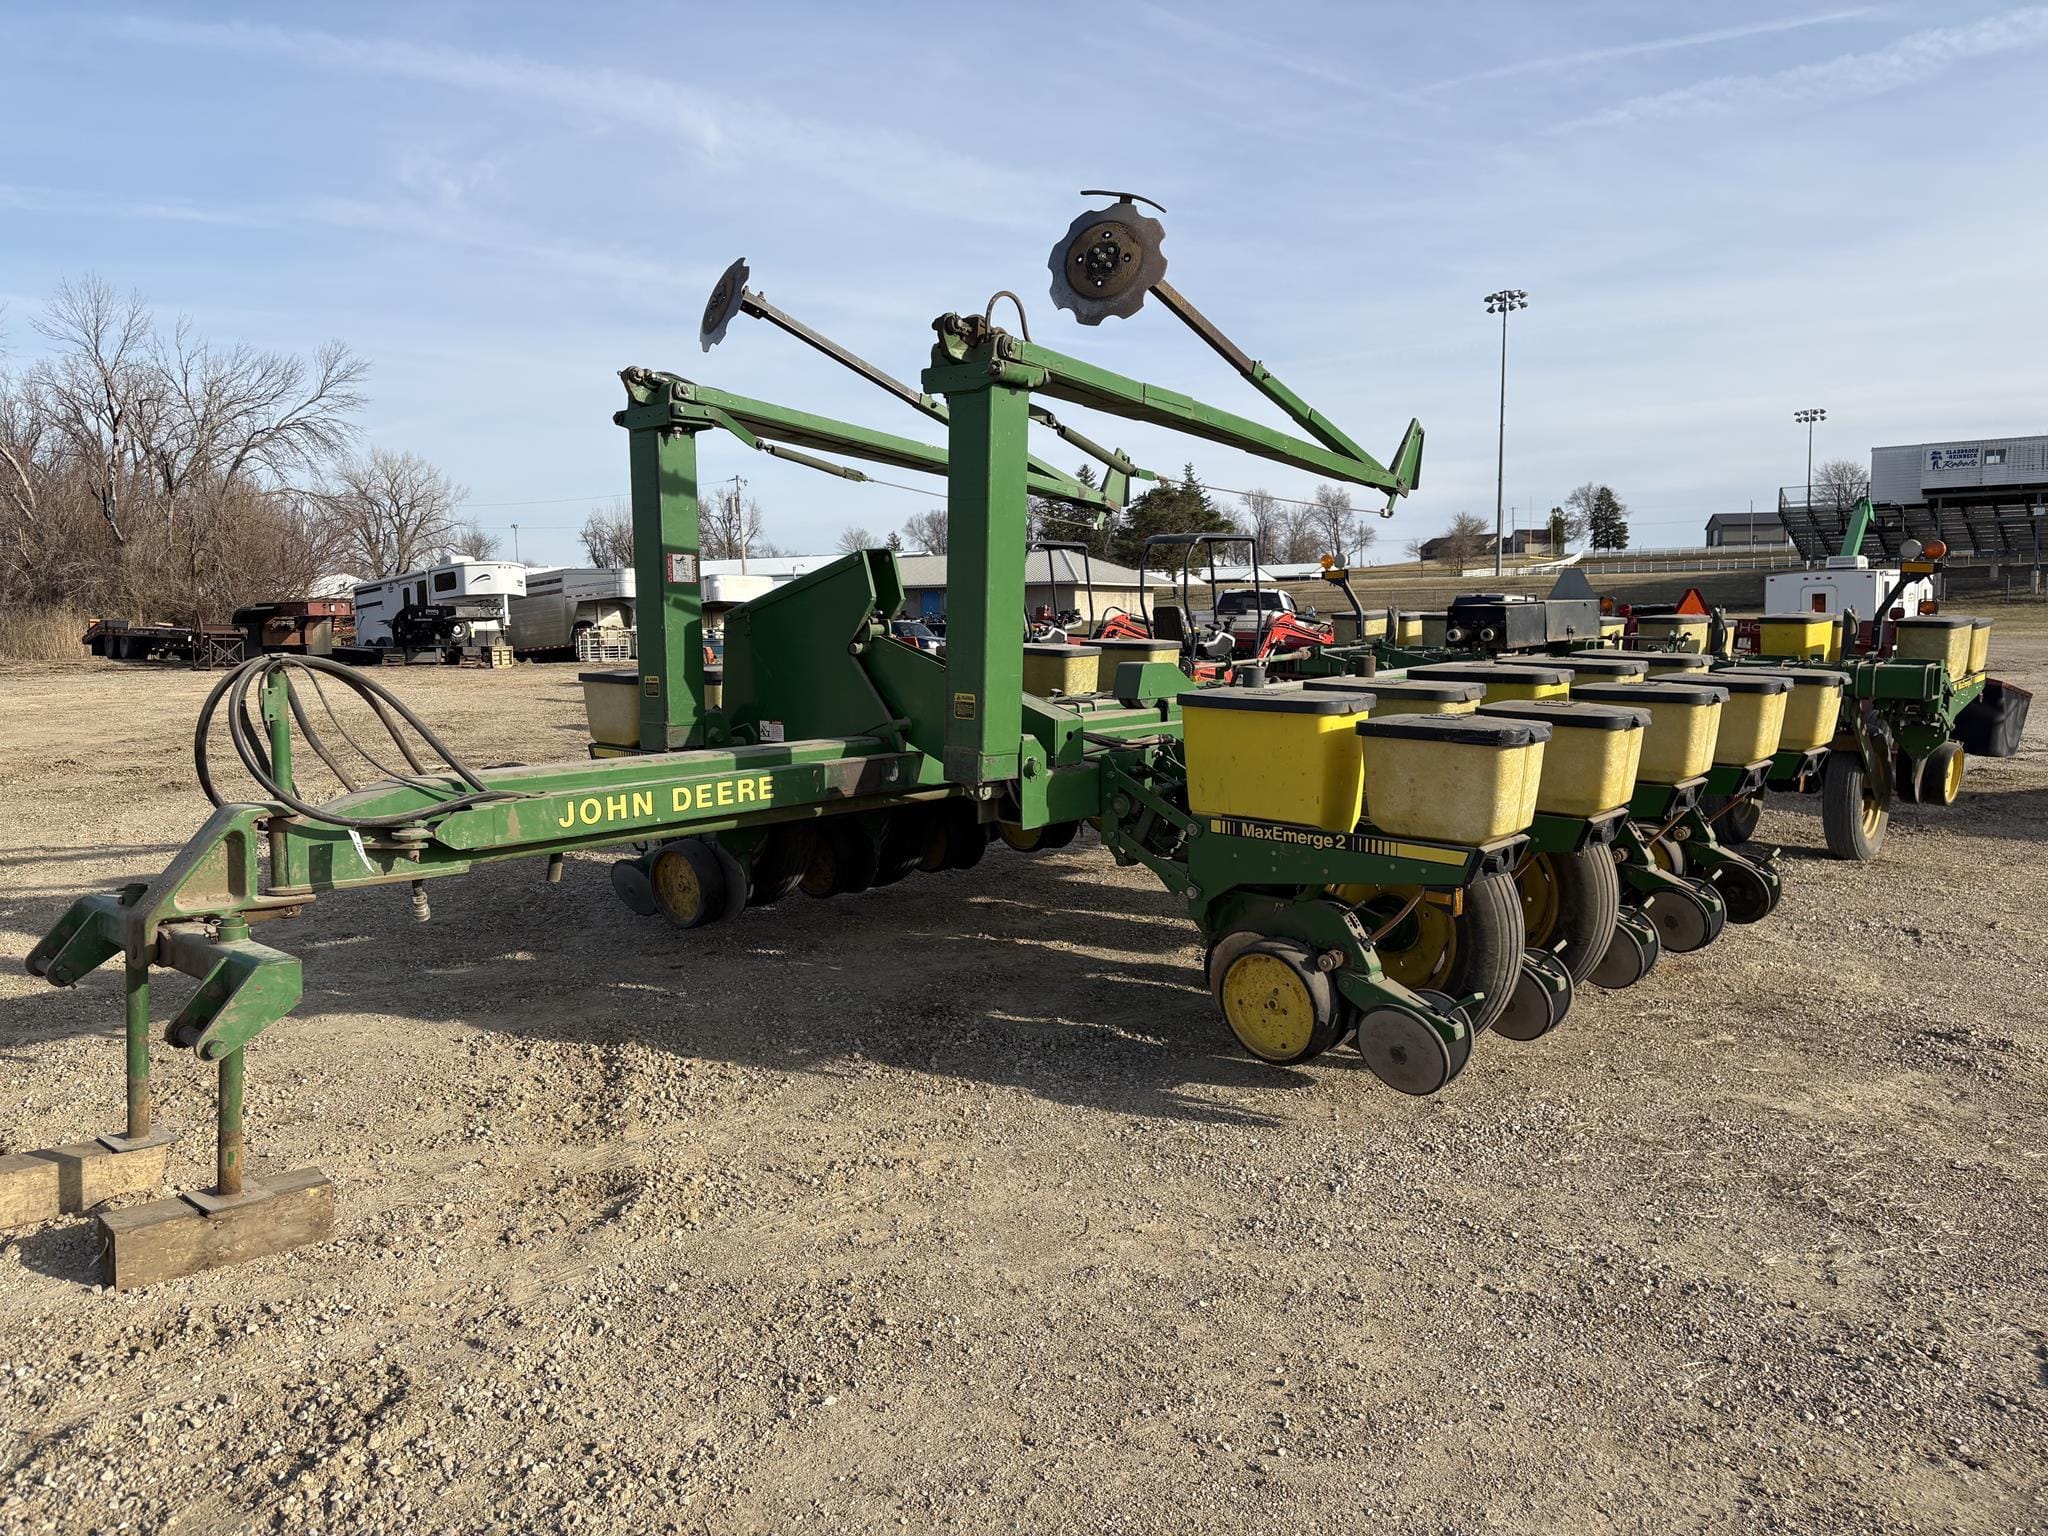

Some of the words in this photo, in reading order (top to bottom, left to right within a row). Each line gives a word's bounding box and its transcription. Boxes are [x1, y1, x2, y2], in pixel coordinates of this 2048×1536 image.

[1942, 459, 1978, 469] Rebels
[558, 790, 653, 829] JOHN
[672, 775, 775, 813] DEERE
